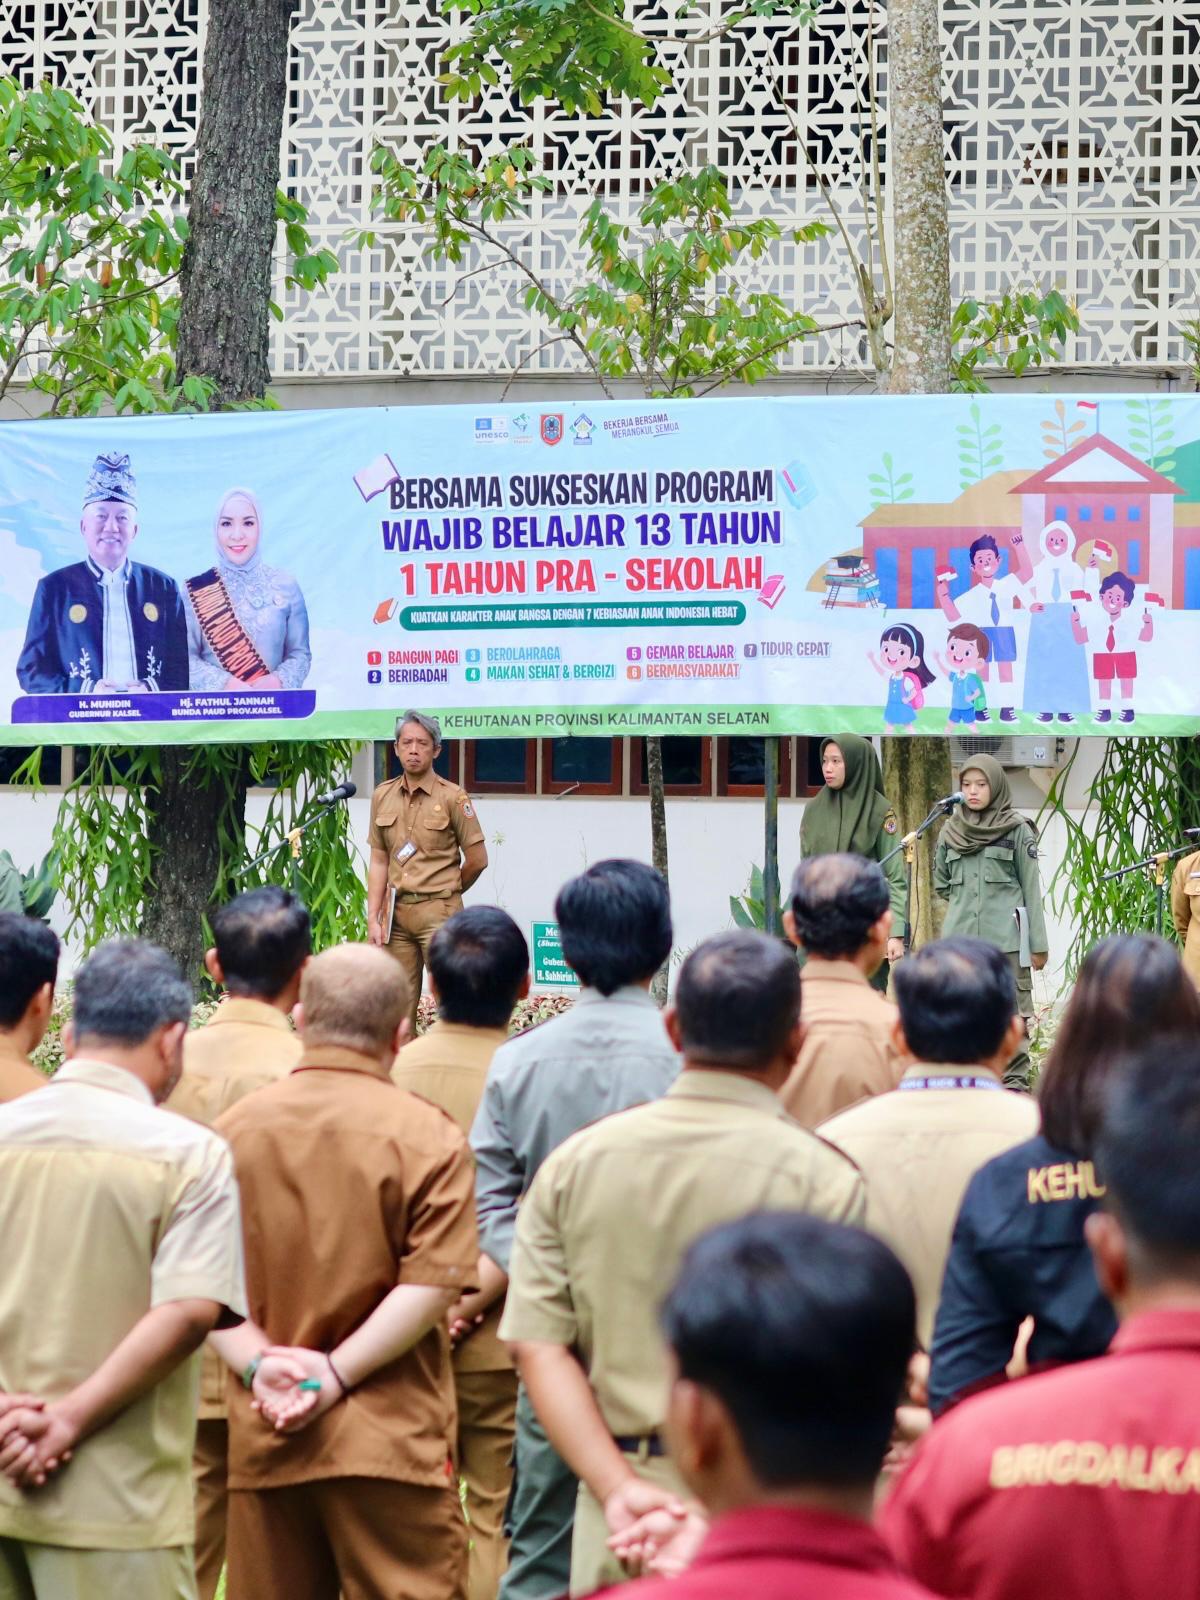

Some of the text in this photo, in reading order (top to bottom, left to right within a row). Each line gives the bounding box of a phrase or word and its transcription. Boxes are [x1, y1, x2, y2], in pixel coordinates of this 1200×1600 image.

[604, 413, 668, 430] BEKERJA BERSAMA
[475, 431, 509, 439] unesco
[612, 423, 679, 438] MERANGKUL SEMUA
[390, 470, 773, 510] BERSAMA SUKSESKAN PROGRAM
[382, 511, 780, 551] WAJIB BELAJAR 13 TAHUN
[400, 564, 414, 594] 1
[426, 561, 526, 594] TAHUN
[536, 559, 596, 592] PRA
[626, 556, 762, 590] SEKOLAH
[411, 606, 738, 623] KUATKAN KARAKTER ANAK BANGSA DENGAN 7 KEBIASAAN ANAK INDONESIA HEBAT
[487, 647, 560, 661] BEROLAHRAGA
[647, 645, 685, 659] GEMAR
[688, 645, 734, 659] BELAJAR
[761, 642, 792, 656] TIDUR
[797, 642, 829, 656] CEPAT
[388, 651, 432, 664] BANGUN
[435, 650, 458, 663] PAGI
[388, 669, 447, 683] BERIBADAH
[487, 665, 524, 679] MAKAN
[529, 665, 560, 679] SEHAT
[563, 665, 570, 678] &
[574, 664, 615, 678] BERGIZI
[647, 663, 739, 678] BERMASYARAKAT
[90, 700, 131, 708] MUHIDIN
[180, 697, 274, 708] Hj. FATHUL JANNAH
[69, 710, 111, 718] GUBERNUR
[172, 708, 201, 716] BUNDA
[203, 708, 225, 716] PAUD
[444, 715, 530, 727] KEHUTANAN
[536, 713, 603, 726] PROVINSI
[608, 713, 701, 725] KALIMANTAN
[707, 712, 769, 724] SELATAN
[545, 927, 560, 937] Me
